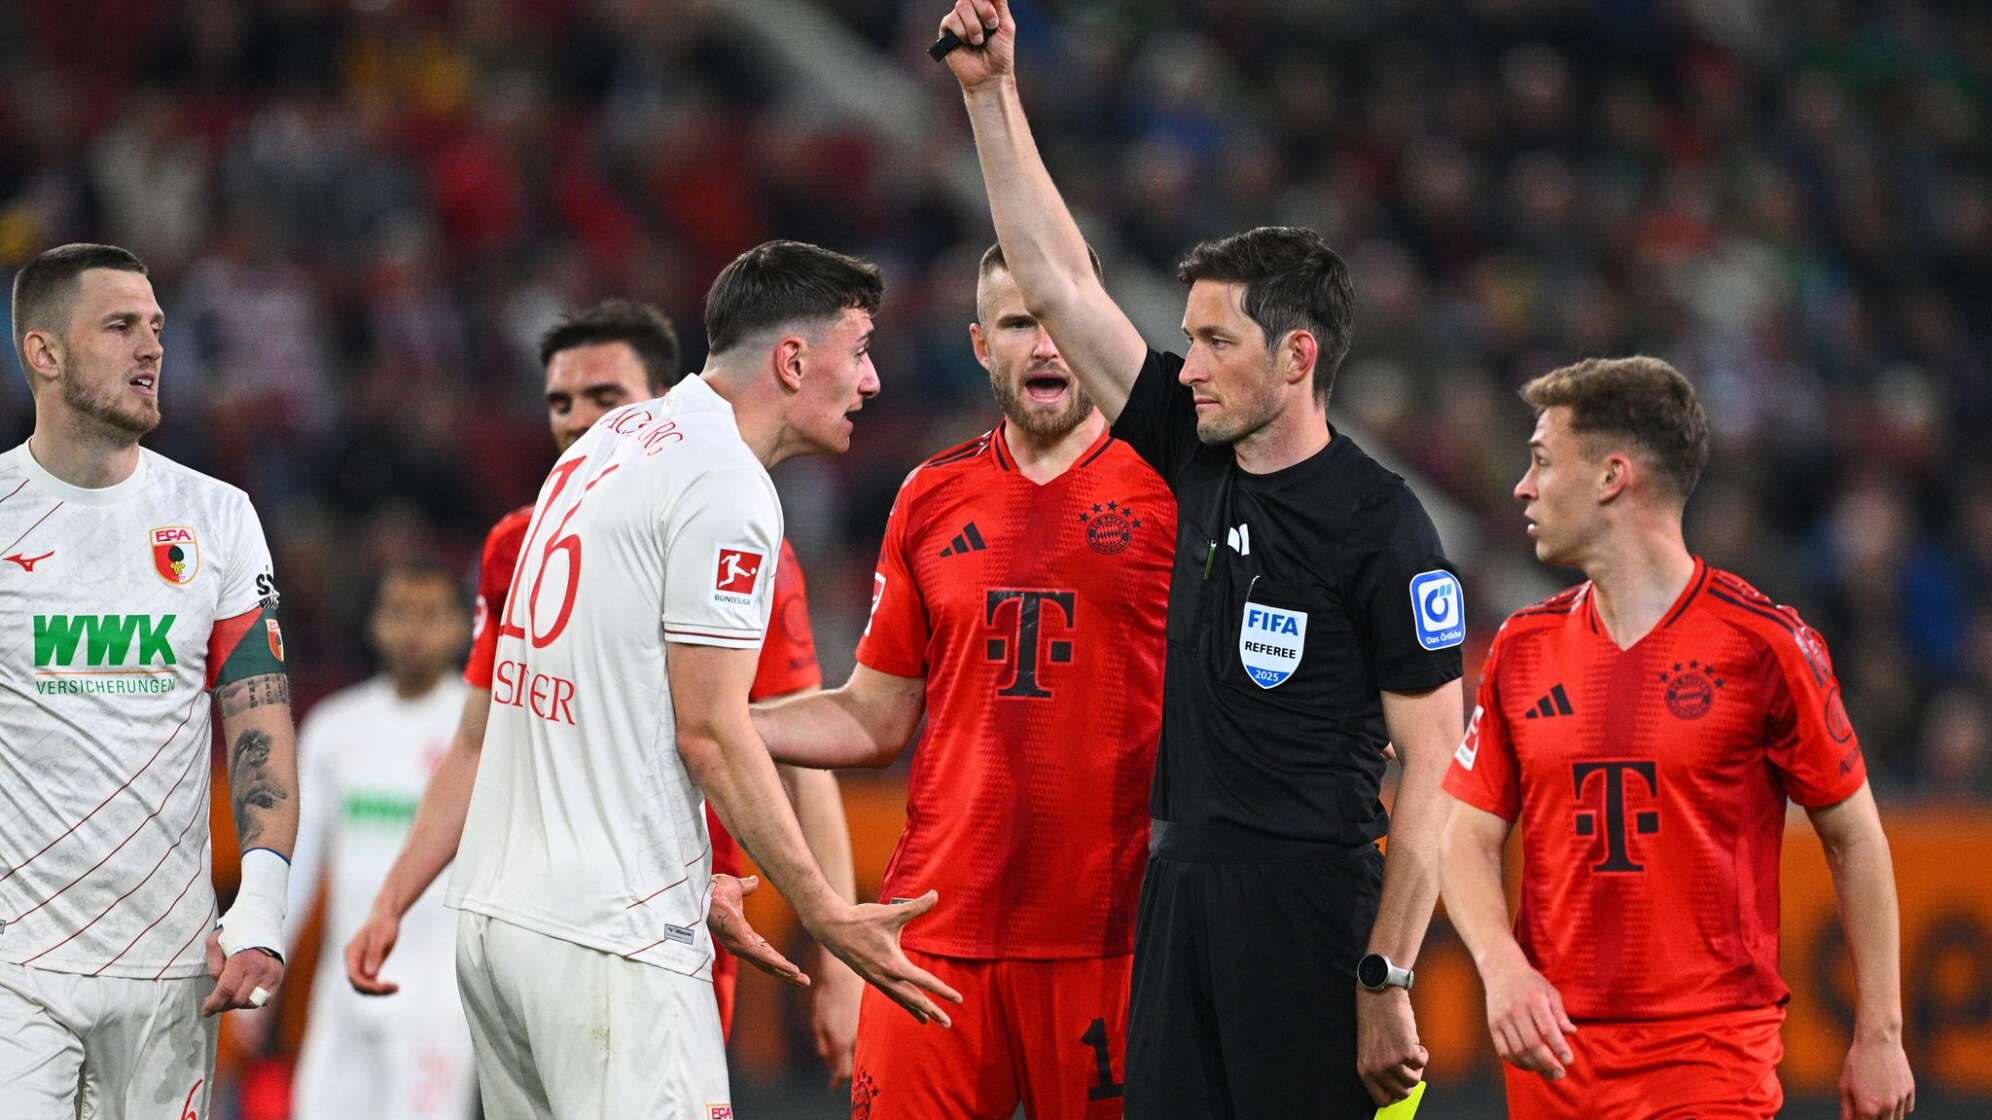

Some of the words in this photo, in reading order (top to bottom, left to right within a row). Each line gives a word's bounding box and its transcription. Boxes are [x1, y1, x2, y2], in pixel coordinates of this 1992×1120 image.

[1247, 609, 1299, 636] FIFA
[33, 614, 177, 667] WWK
[985, 588, 1075, 700] T
[1244, 641, 1297, 660] REFEREE
[1426, 635, 1440, 645] Das
[36, 678, 176, 695] VERSICHERUNGEN
[1255, 669, 1279, 682] 2025
[1572, 762, 1659, 873] T
